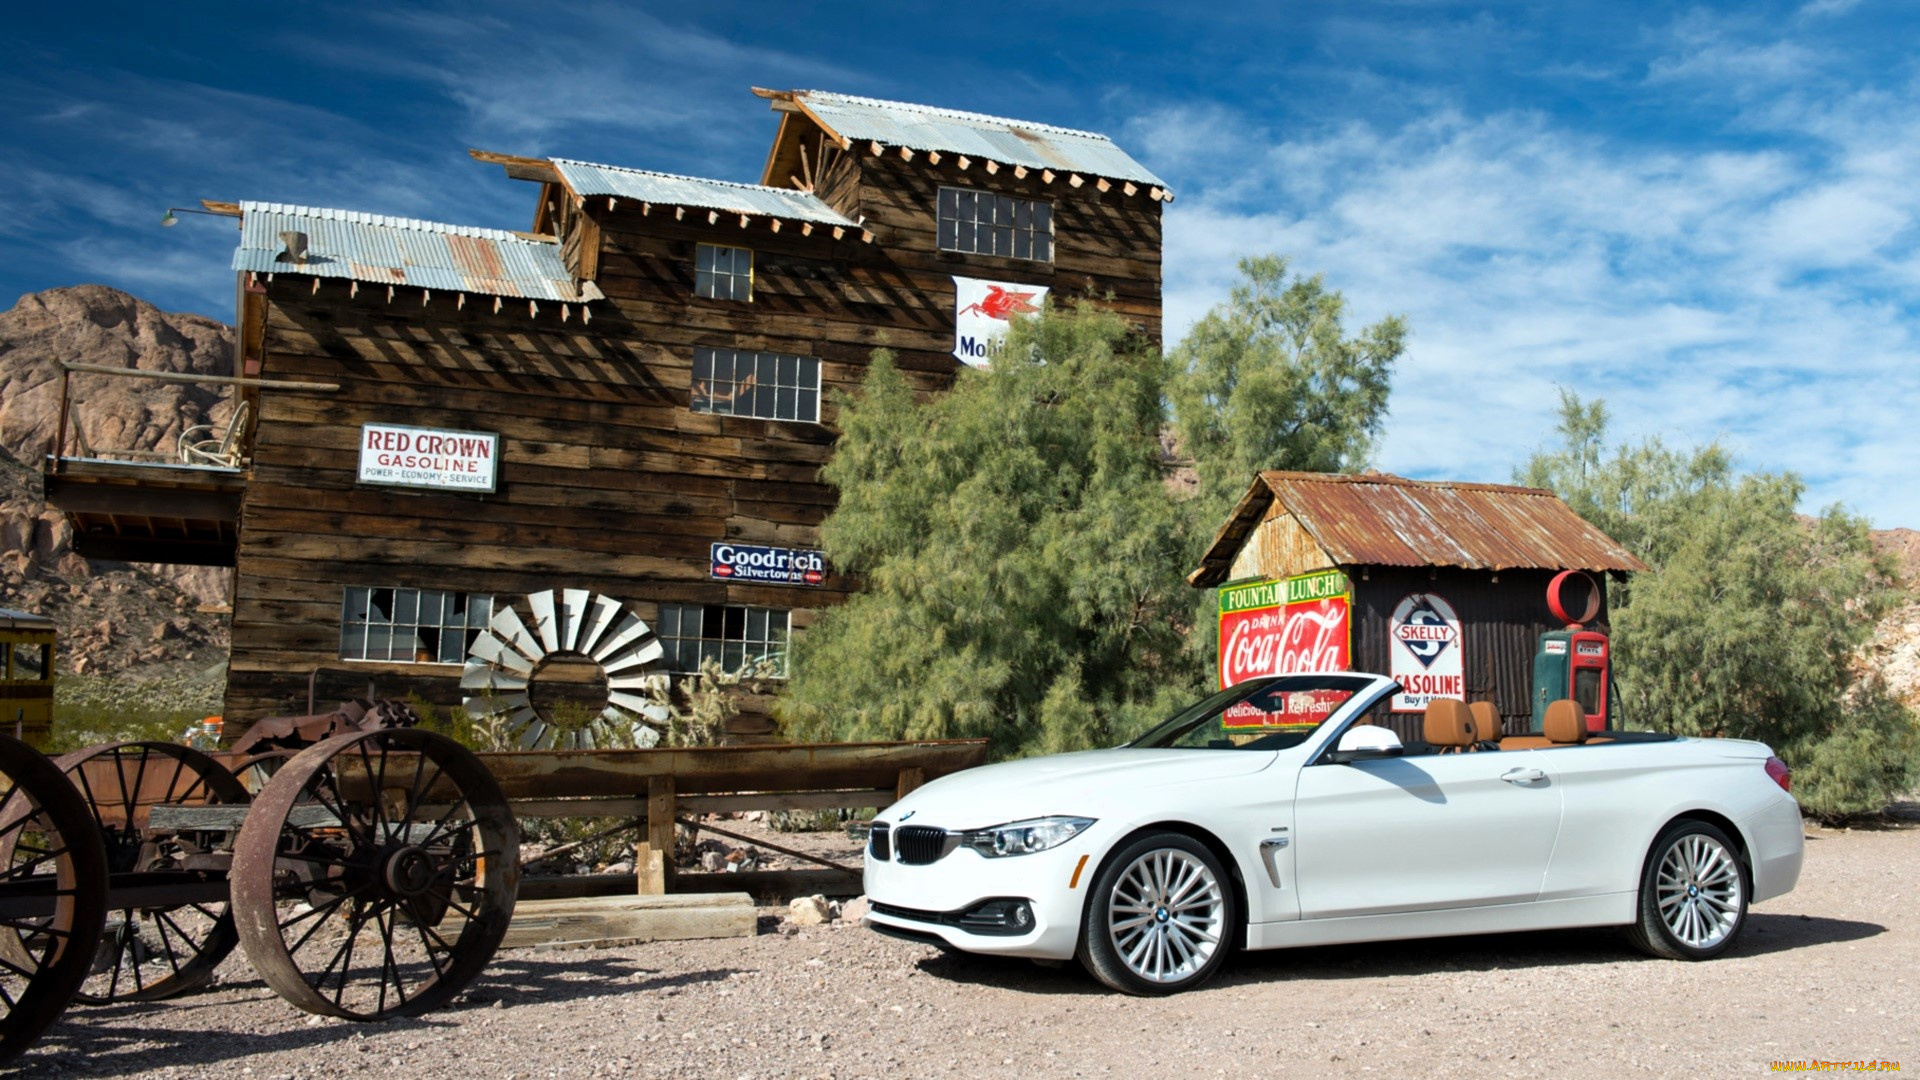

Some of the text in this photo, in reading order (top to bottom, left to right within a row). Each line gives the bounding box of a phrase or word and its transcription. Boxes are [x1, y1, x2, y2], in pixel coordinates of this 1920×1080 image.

[367, 430, 491, 459] RED CROWN
[377, 453, 479, 473] GASOLINE
[365, 467, 393, 477] POWER
[401, 470, 442, 480] ECONOMY
[449, 474, 488, 484] SERVICE
[716, 546, 823, 571] Goodrich
[734, 565, 803, 580] Silvertowns
[1228, 574, 1335, 609] FOUNTAIN LUNCH
[1401, 625, 1449, 640] SKELLY
[1223, 606, 1346, 689] Coca-Cola
[1288, 696, 1334, 715] Refreshi
[1404, 695, 1421, 706] Buy
